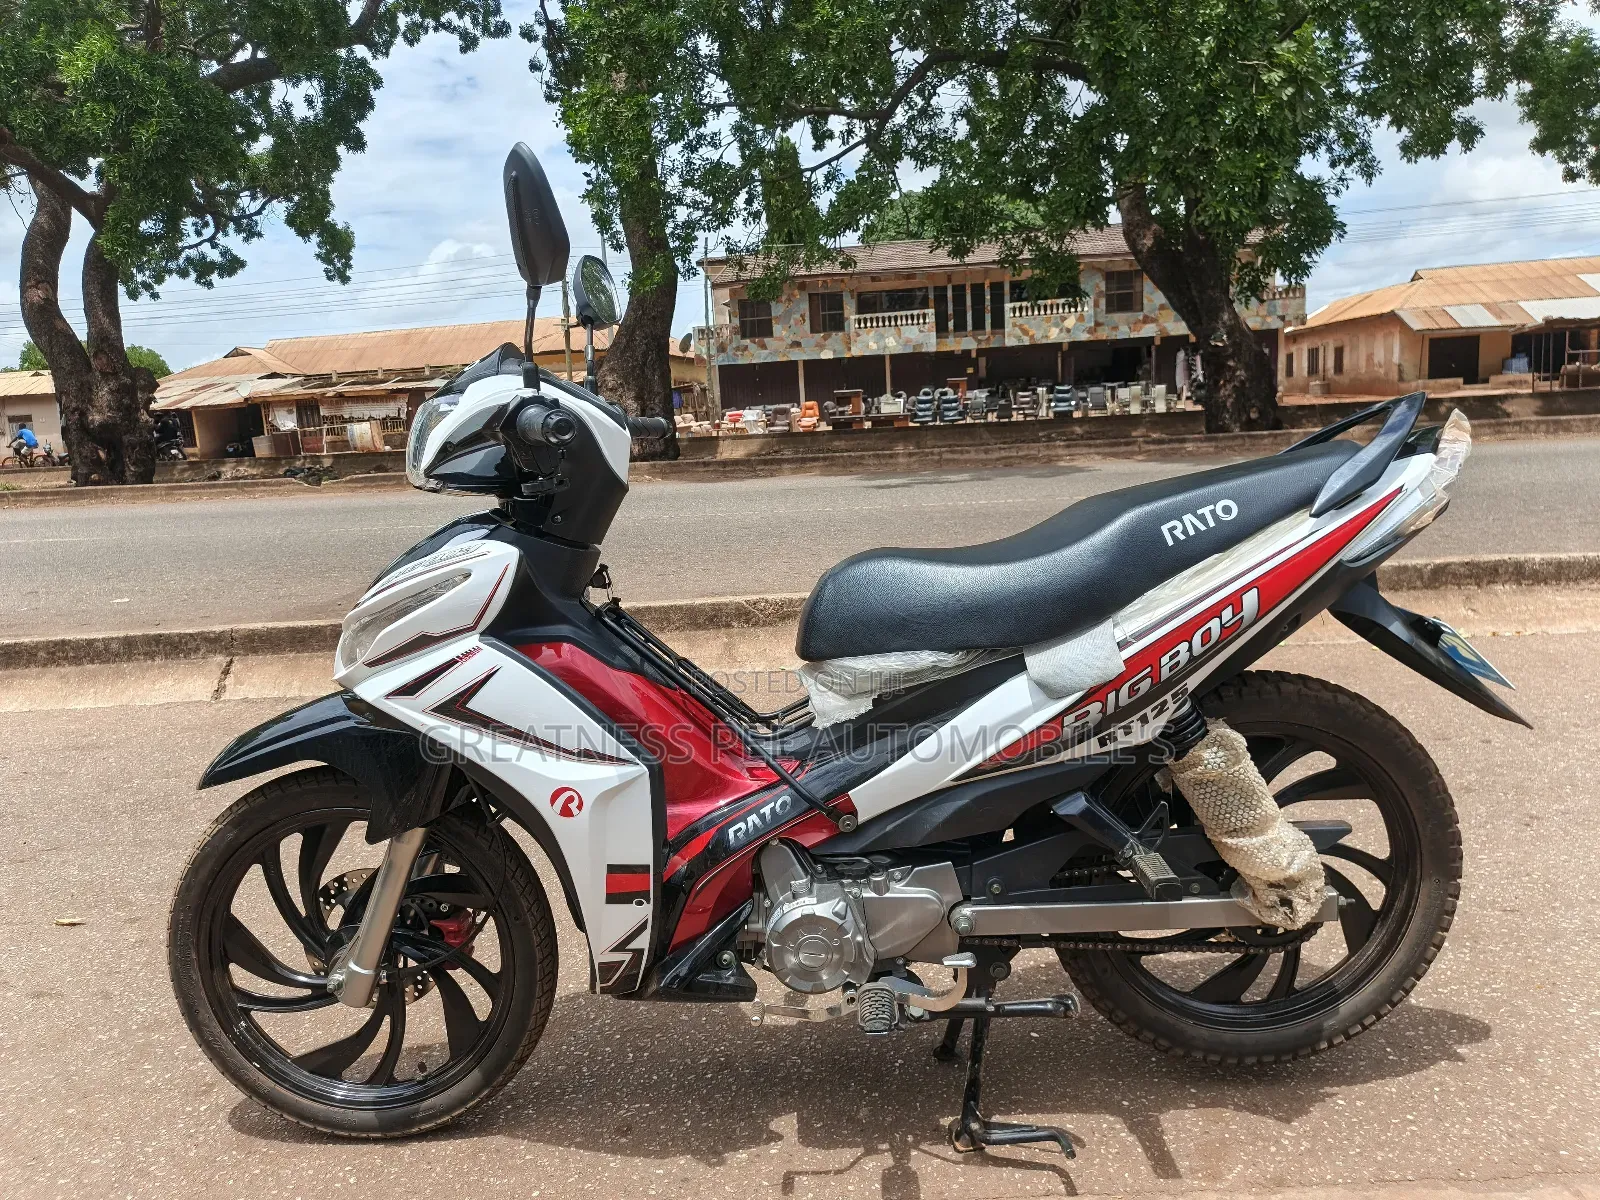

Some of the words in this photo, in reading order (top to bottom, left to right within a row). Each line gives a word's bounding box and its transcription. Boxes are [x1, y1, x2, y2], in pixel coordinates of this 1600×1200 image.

[1160, 498, 1239, 547] RATO
[1062, 666, 1155, 741] BIG
[1159, 586, 1260, 682] BOY
[727, 796, 792, 846] RATO
